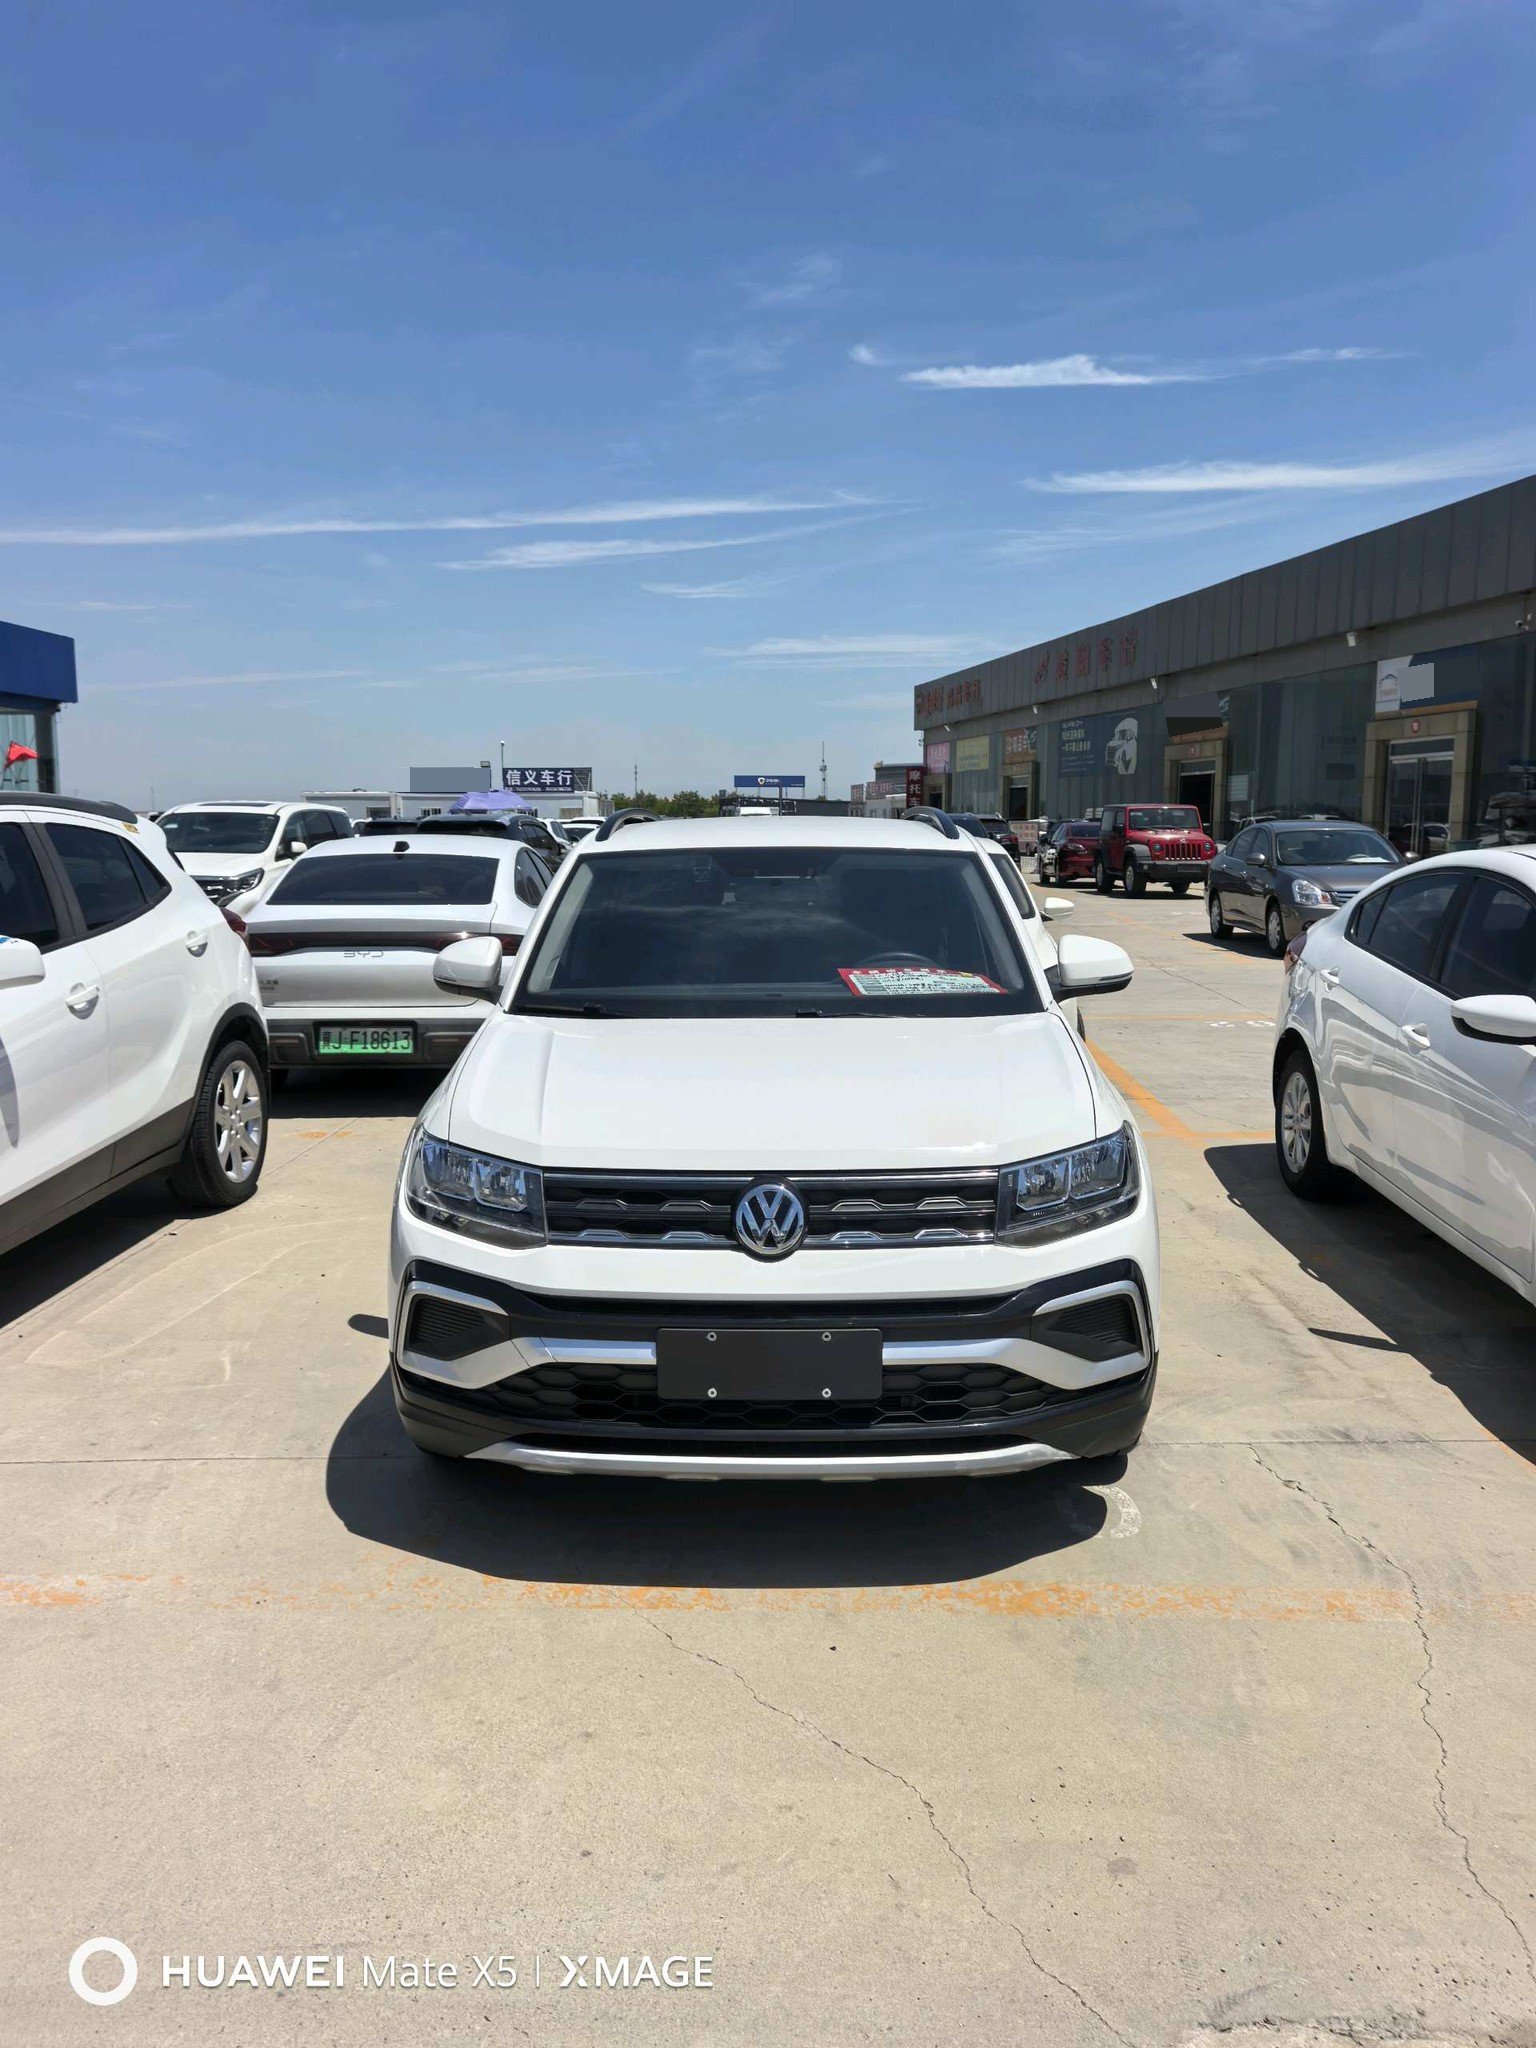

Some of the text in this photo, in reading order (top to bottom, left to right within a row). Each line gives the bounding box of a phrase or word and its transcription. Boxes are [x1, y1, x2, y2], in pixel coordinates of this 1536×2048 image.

[506, 769, 573, 786] 信义车行
[343, 949, 384, 958] BYD
